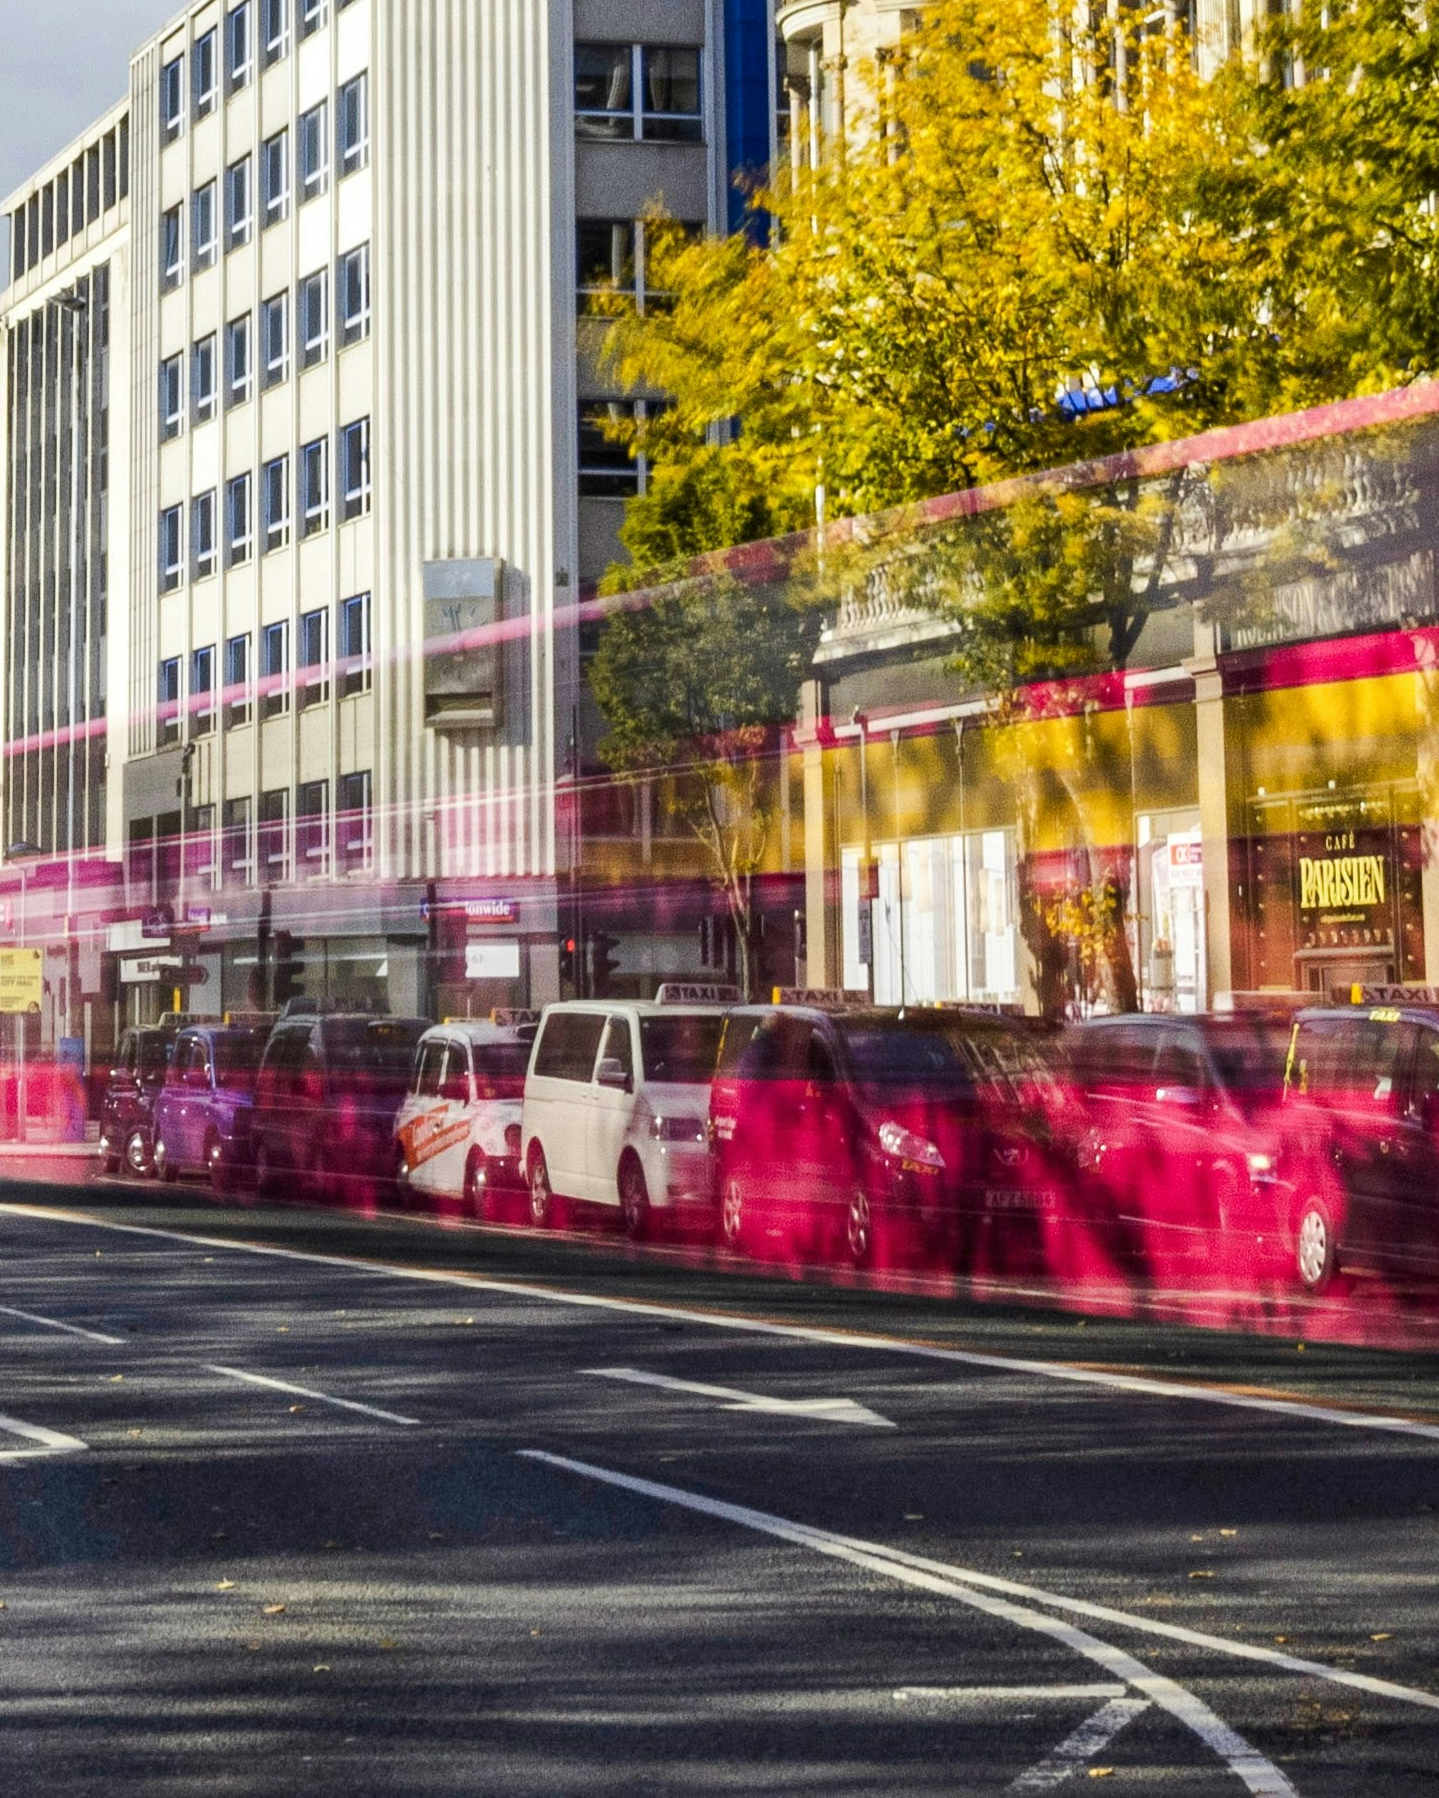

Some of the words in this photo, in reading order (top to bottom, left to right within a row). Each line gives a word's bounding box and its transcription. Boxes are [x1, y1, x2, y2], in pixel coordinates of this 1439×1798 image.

[1325, 830, 1355, 851] CAFÉ
[1299, 855, 1385, 909] PARISIEN
[682, 985, 716, 1000] TAXI
[1374, 987, 1429, 1002] TAXI
[1369, 1010, 1402, 1022] TAXI
